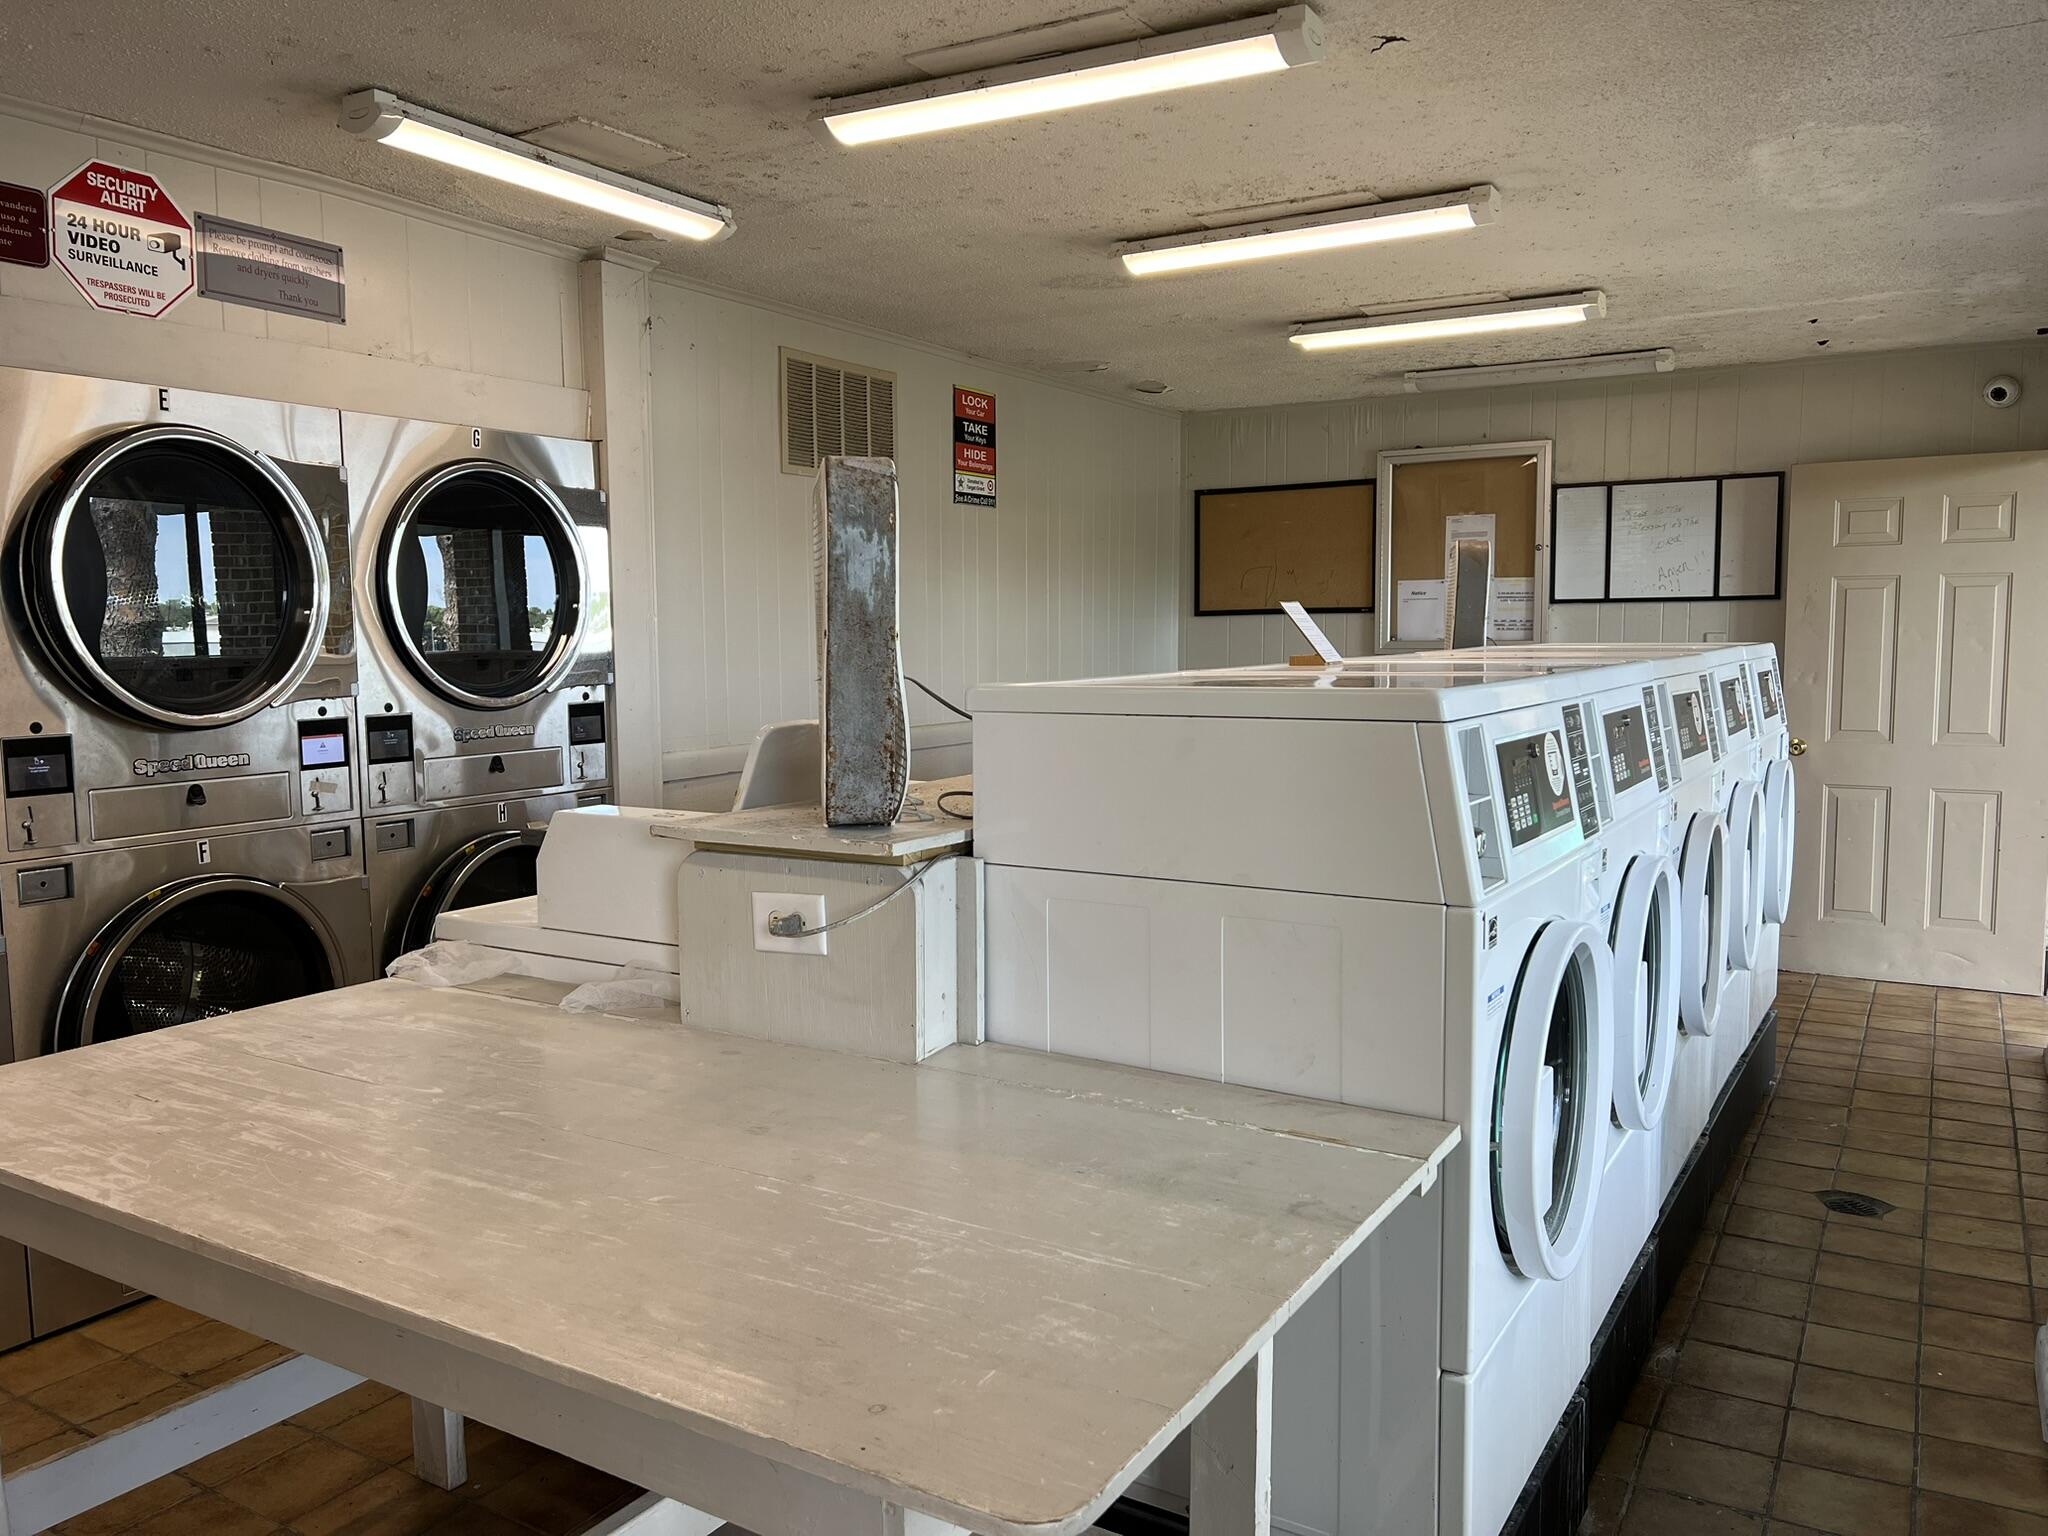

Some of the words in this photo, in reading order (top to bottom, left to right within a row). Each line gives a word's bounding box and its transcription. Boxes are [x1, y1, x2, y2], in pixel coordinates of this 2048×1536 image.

[86, 171, 158, 201] SECURITY
[100, 190, 146, 213] ALERT
[19, 215, 29, 224] de
[67, 213, 88, 230] 24
[92, 218, 141, 241] HOUR
[0, 224, 32, 237] identes
[67, 230, 120, 254] VIDEO
[208, 228, 234, 243] Please
[237, 235, 246, 246] be
[248, 238, 278, 256] prompt
[279, 246, 293, 257] and
[68, 248, 158, 277] SURVEILLANCE
[212, 242, 246, 258] Remove
[247, 250, 280, 269] clothing
[281, 257, 300, 271] from
[301, 263, 333, 278] washers
[236, 263, 252, 274] and
[254, 267, 280, 281] dryers
[281, 271, 310, 287] quickly.
[86, 277, 137, 295] TRESPASSERS
[137, 287, 154, 299] WILL
[157, 291, 167, 301] BE
[278, 289, 303, 304] Thank
[304, 295, 319, 307] you
[104, 291, 151, 307] PROSECUTED
[159, 388, 169, 411] E
[962, 394, 988, 410] LOCK
[965, 408, 976, 416] Your
[976, 409, 985, 418] Car
[962, 421, 988, 436] TAKE
[472, 430, 480, 448] G
[964, 433, 975, 442] Your
[975, 435, 987, 445] Keys
[957, 459, 968, 467] Your
[964, 448, 987, 461] HIDE
[453, 725, 495, 743] Speed
[495, 724, 535, 737] Queen
[133, 755, 194, 777] Speed
[194, 753, 251, 769] Queen
[499, 804, 507, 821] H
[199, 842, 207, 863] F
